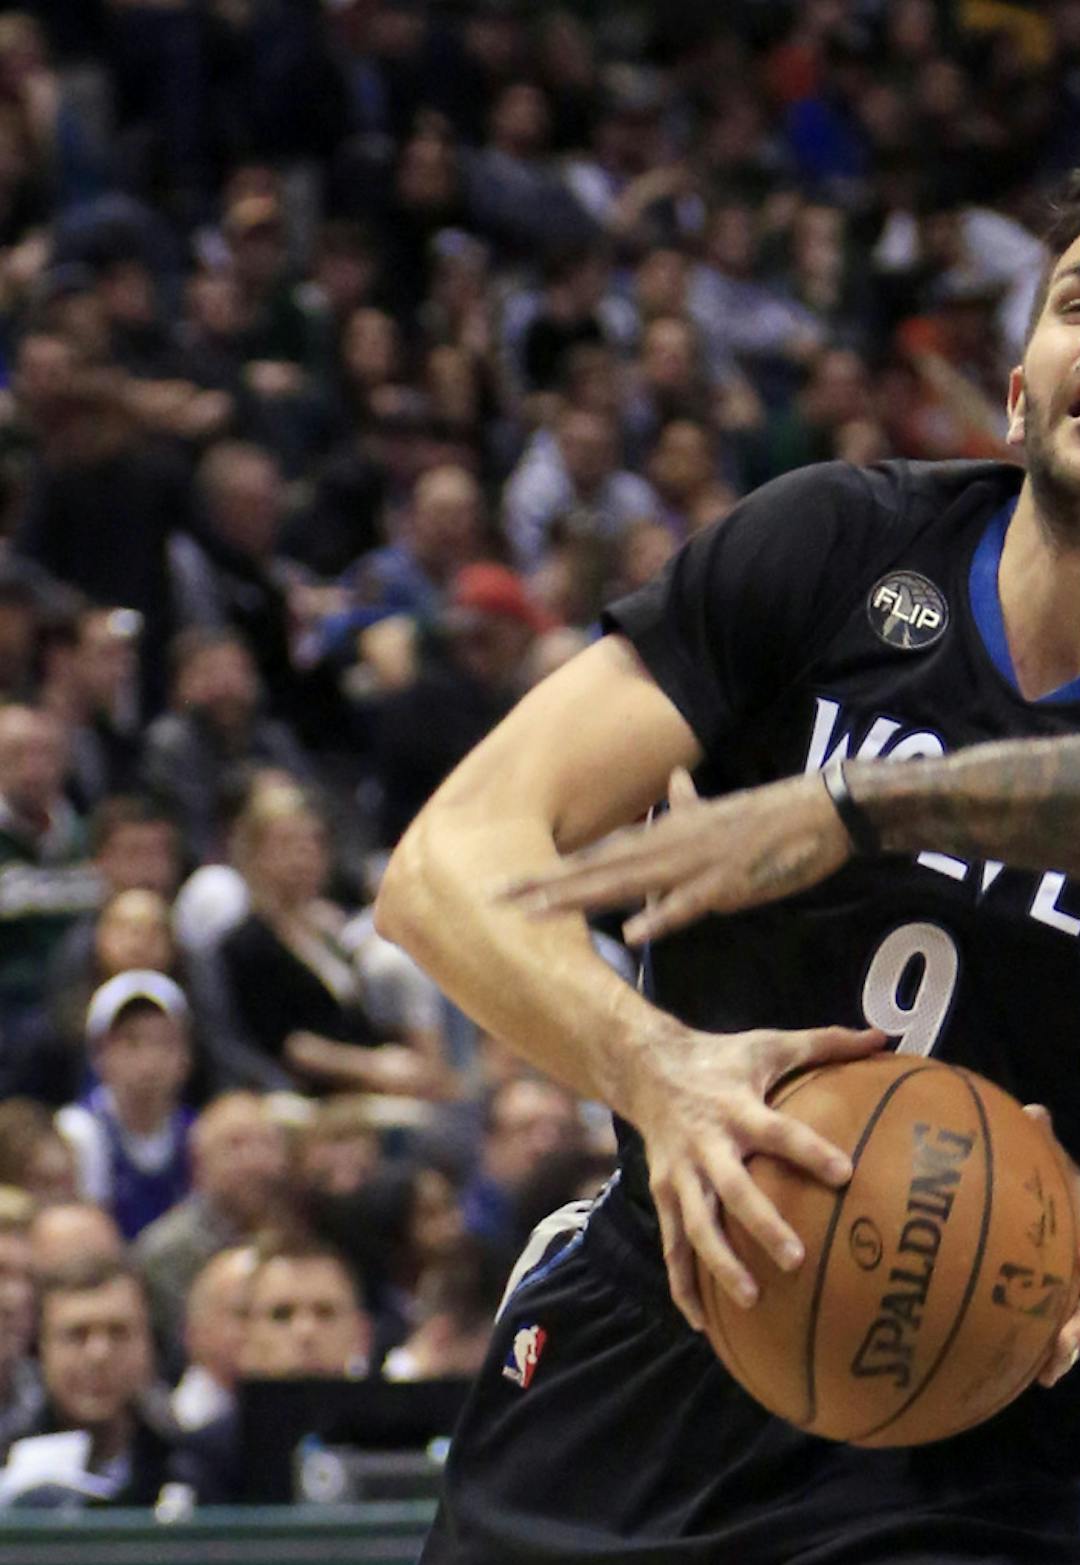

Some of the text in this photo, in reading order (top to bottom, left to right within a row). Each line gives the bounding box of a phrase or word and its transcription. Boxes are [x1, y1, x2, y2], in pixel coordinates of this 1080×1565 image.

[873, 586, 941, 628] FLIP
[862, 922, 958, 1057] 9
[852, 1122, 976, 1390] SPALDING
